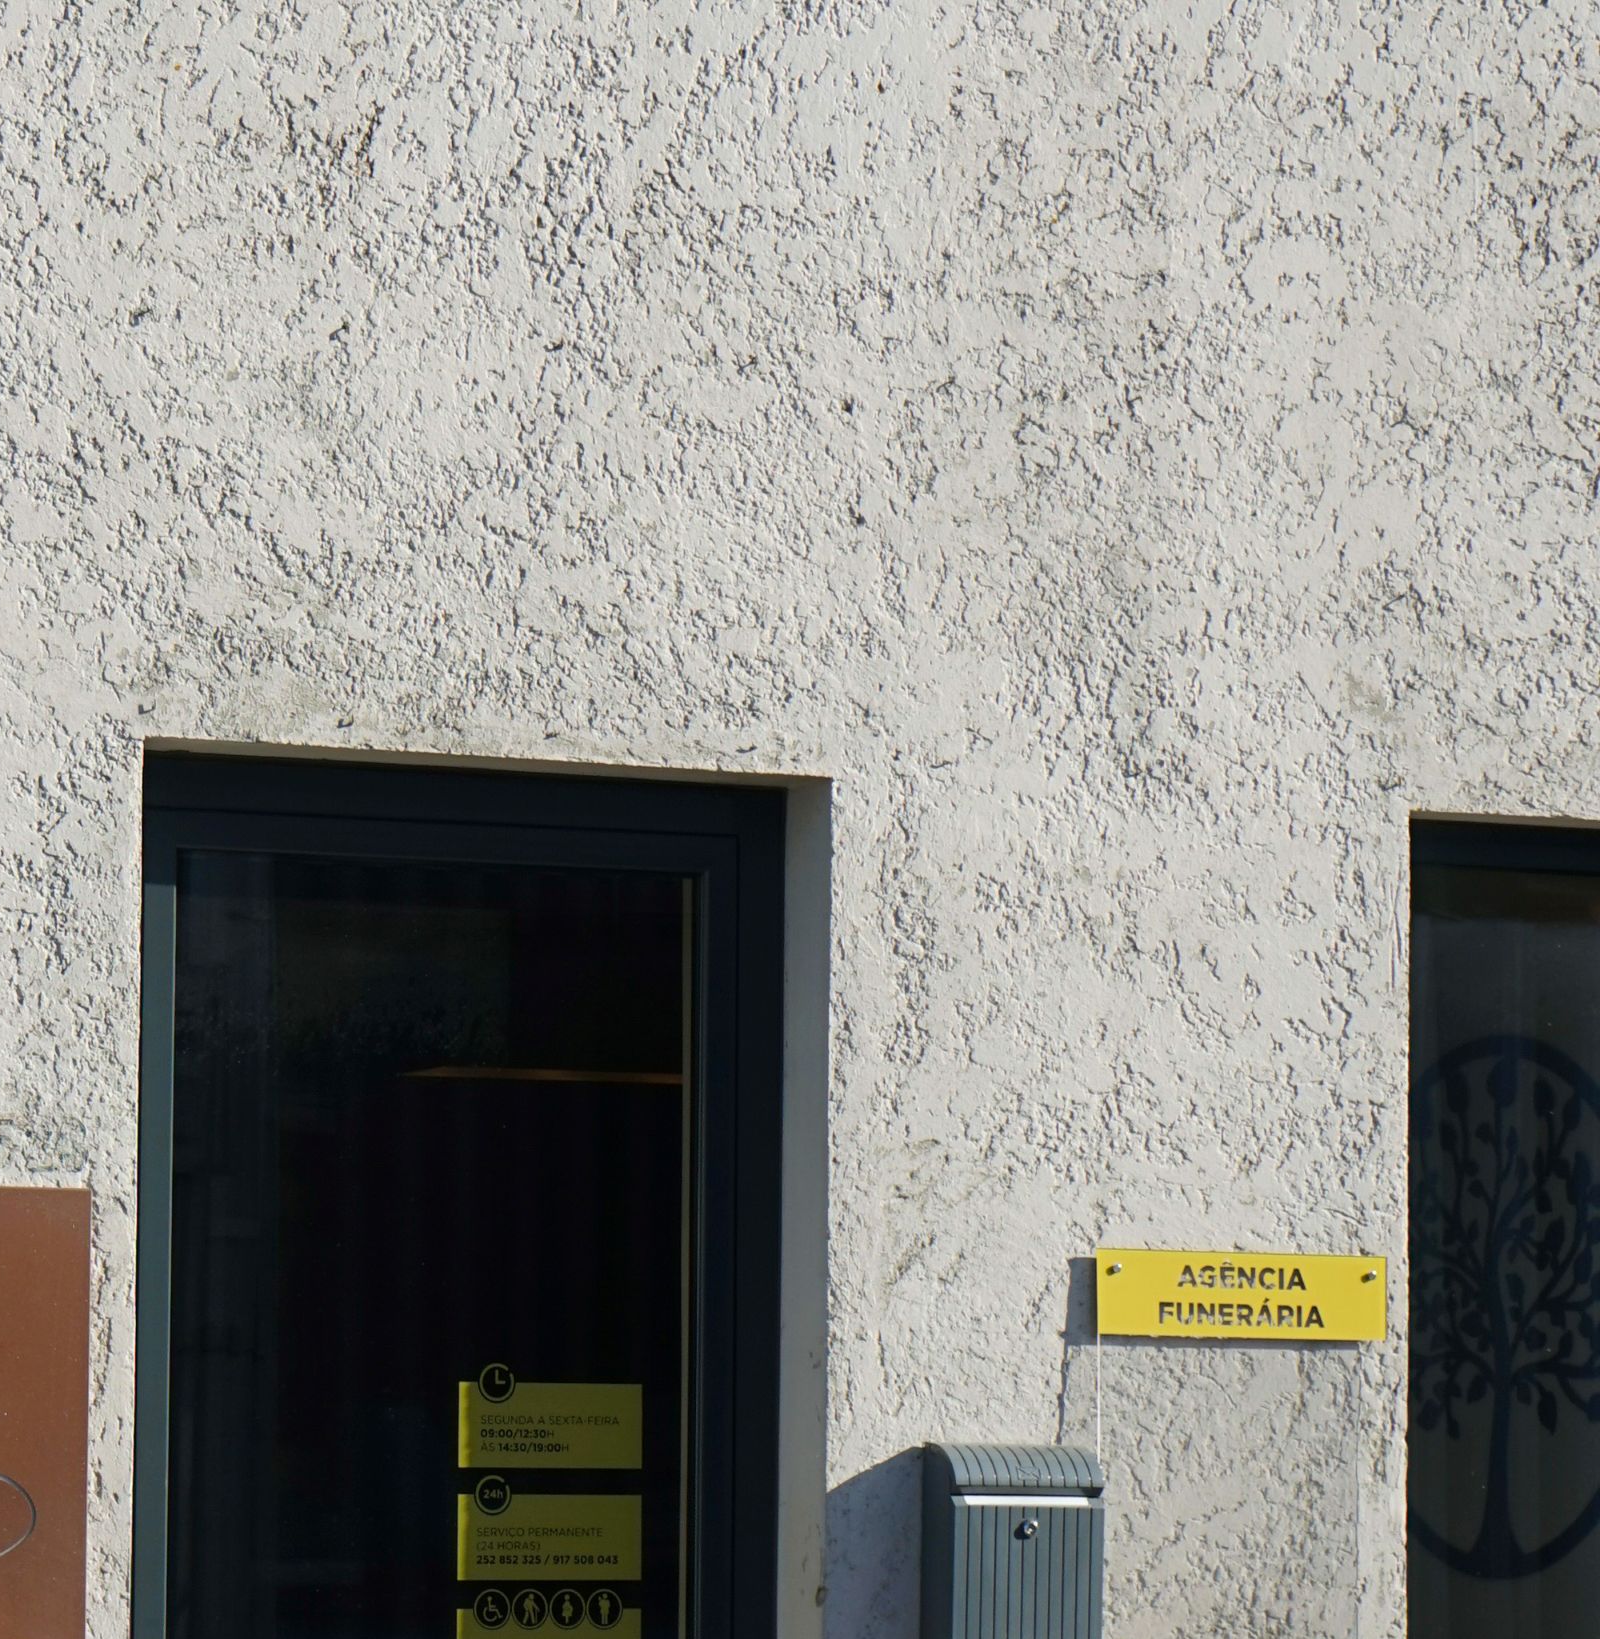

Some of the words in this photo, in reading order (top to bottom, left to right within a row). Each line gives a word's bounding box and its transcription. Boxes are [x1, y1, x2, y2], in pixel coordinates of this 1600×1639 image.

[1177, 1262, 1306, 1291] AGÊNCIA
[1158, 1298, 1325, 1328] FUNERÁRIA
[480, 1415, 534, 1425] SEGUNDA
[537, 1416, 546, 1425] A
[549, 1416, 620, 1426] SEXTA-FEIRA
[483, 1489, 504, 1499] 24h
[476, 1528, 525, 1539] SERVIÇO
[528, 1528, 604, 1537] PERMANENTE
[497, 1541, 541, 1553] HORAS)
[476, 1555, 496, 1565] 252
[522, 1555, 542, 1565] 325
[553, 1555, 571, 1565] 917
